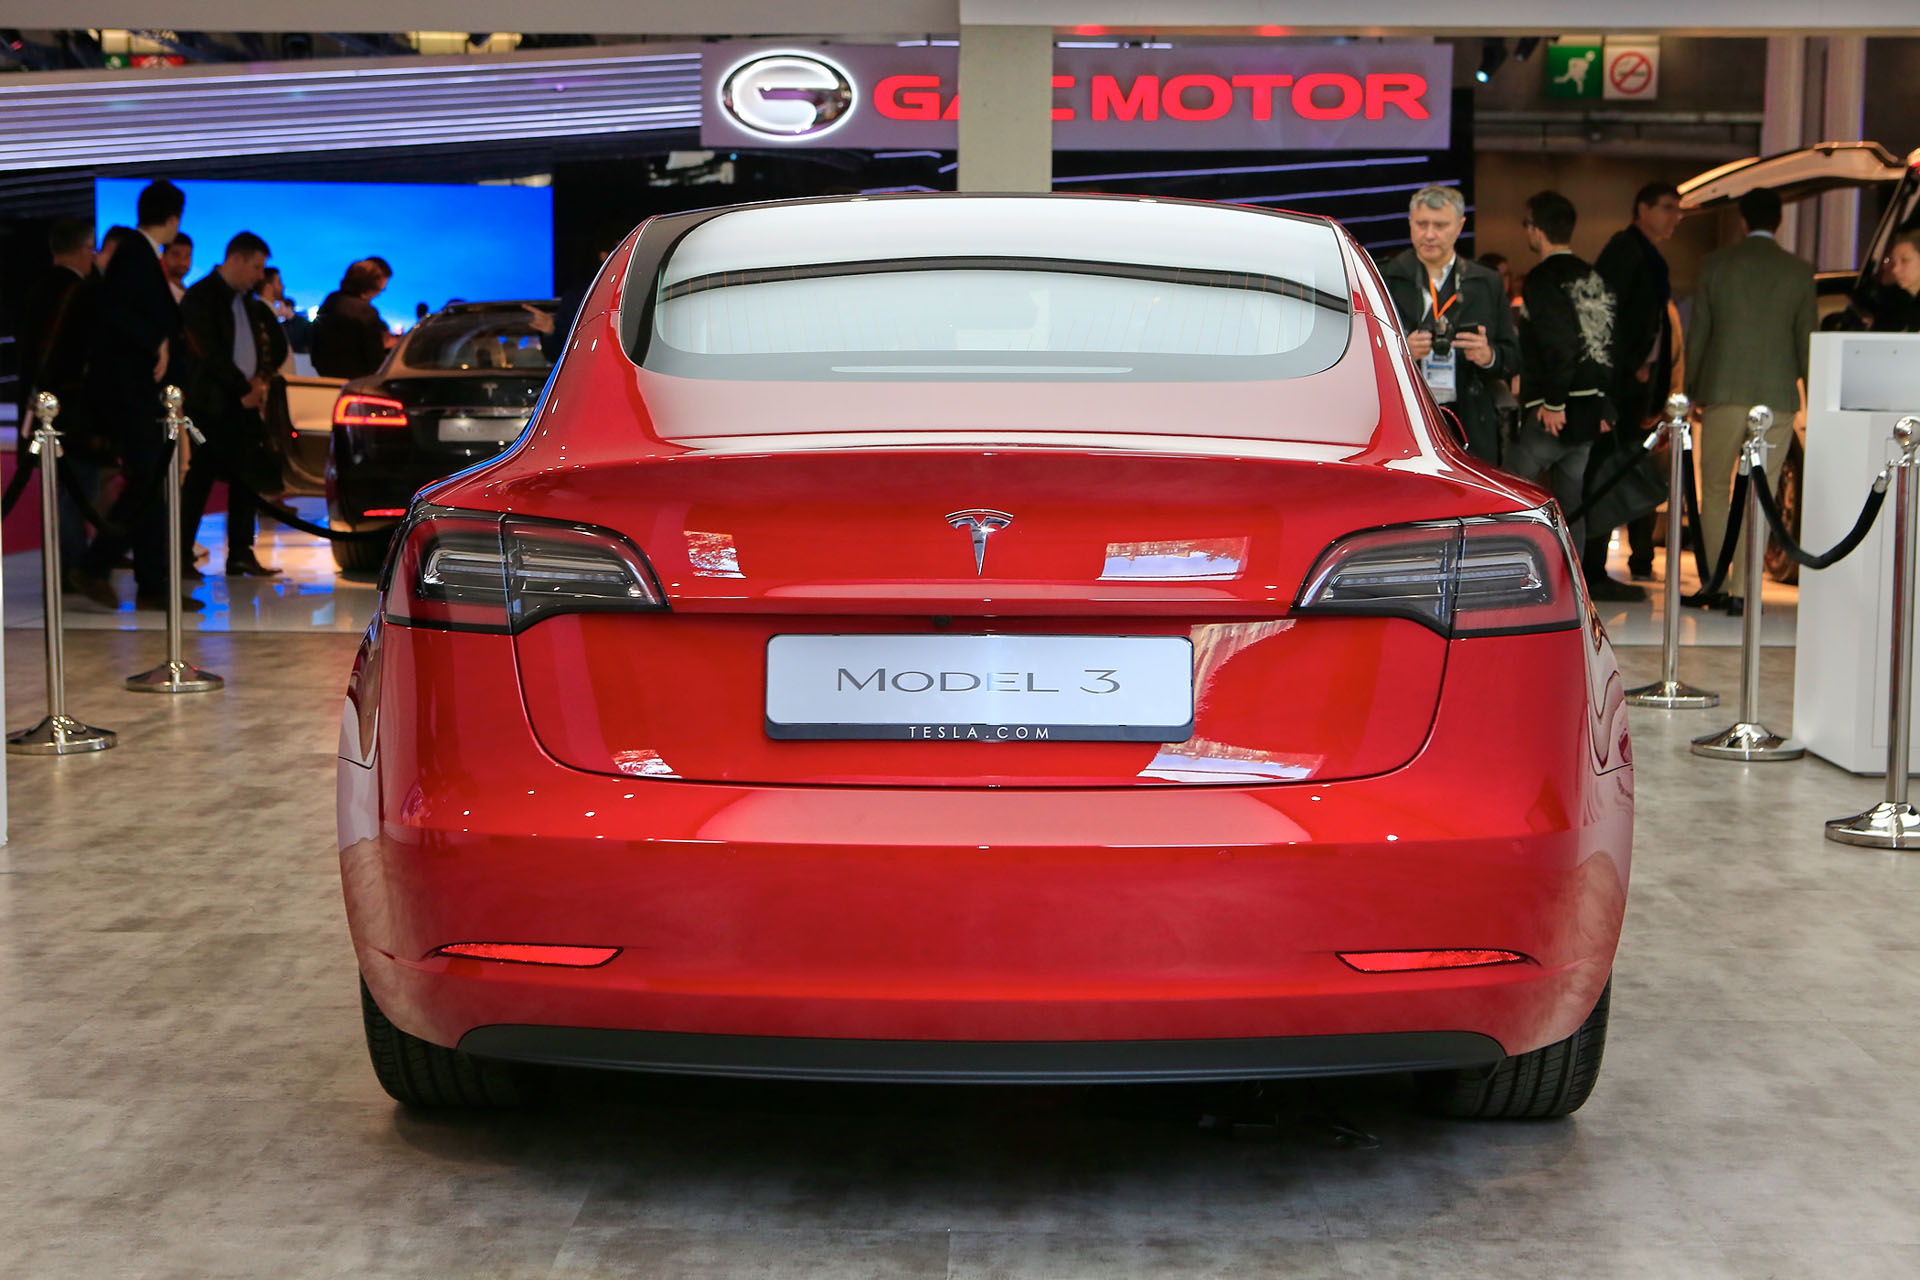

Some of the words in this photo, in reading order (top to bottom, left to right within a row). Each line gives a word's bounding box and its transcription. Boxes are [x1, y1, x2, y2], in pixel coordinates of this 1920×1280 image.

[1091, 74, 1430, 122] MOTOR
[837, 668, 1060, 692] MODEL
[1079, 669, 1121, 694] 3
[908, 726, 1050, 739] TESLA.COM
